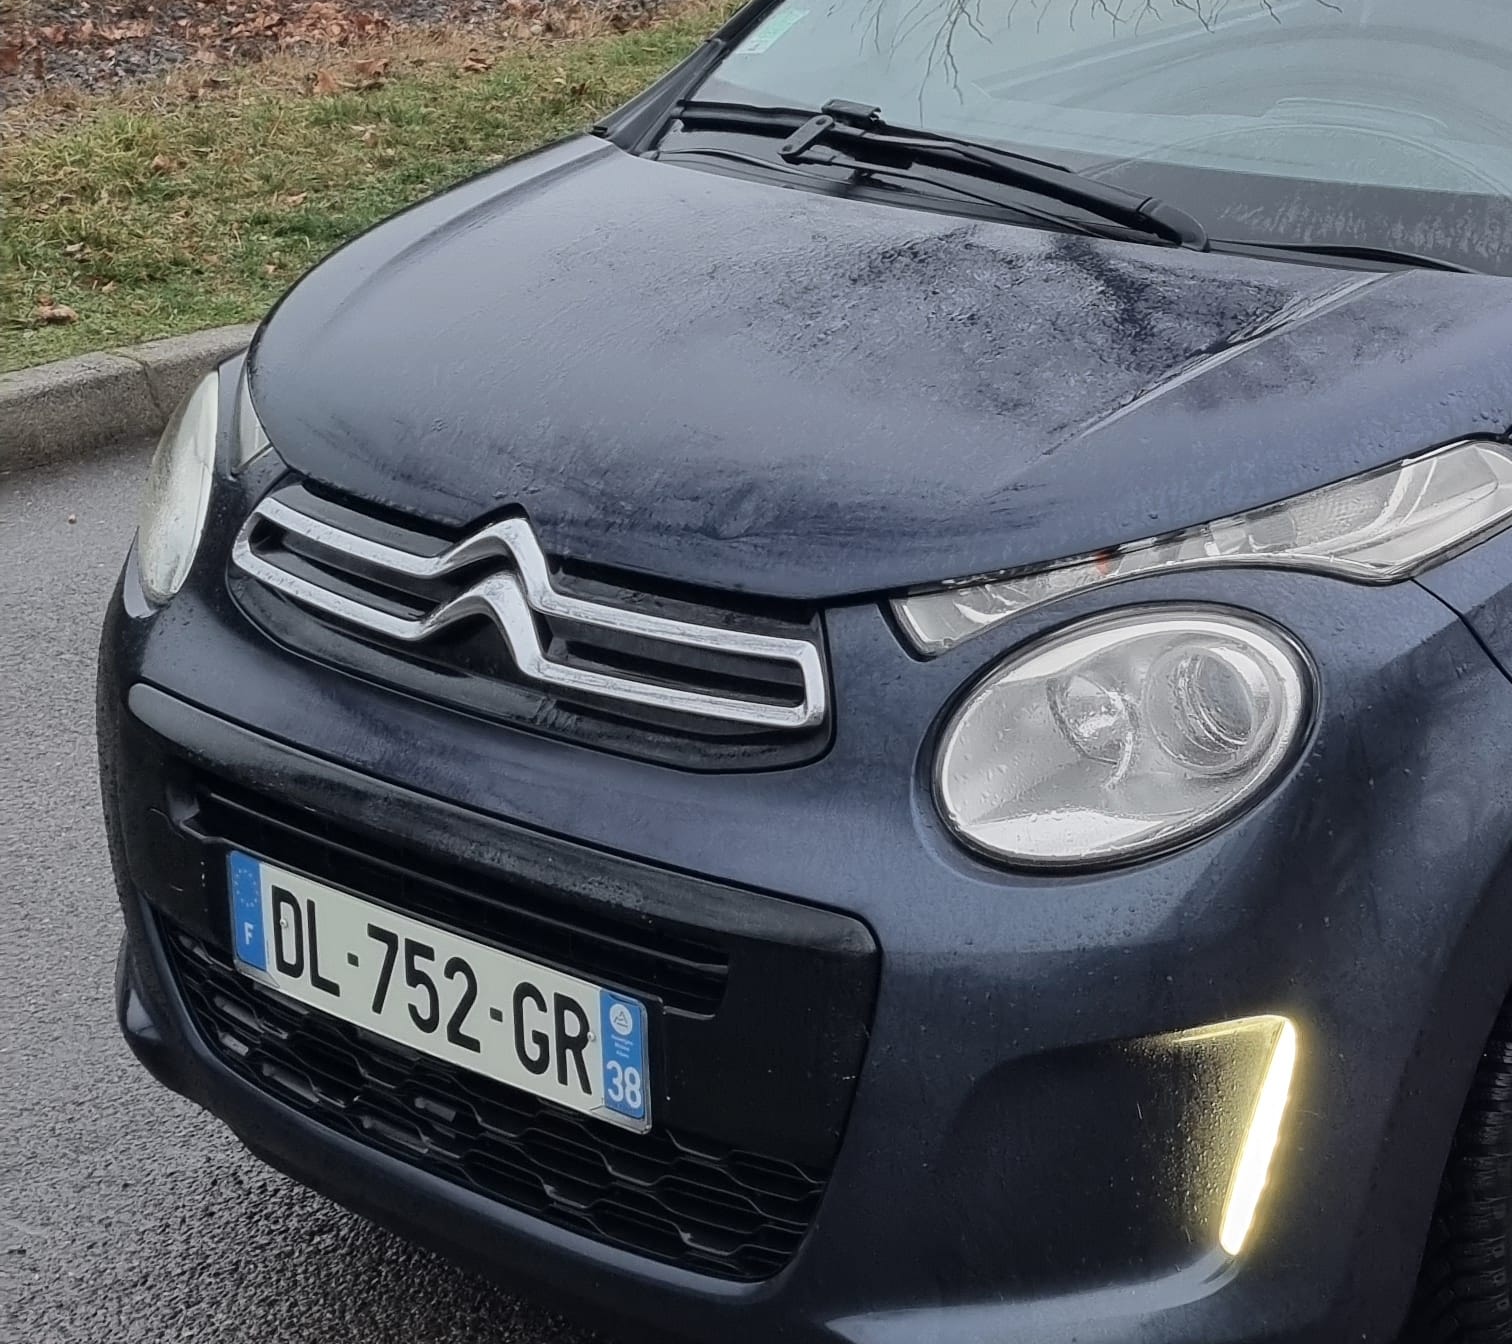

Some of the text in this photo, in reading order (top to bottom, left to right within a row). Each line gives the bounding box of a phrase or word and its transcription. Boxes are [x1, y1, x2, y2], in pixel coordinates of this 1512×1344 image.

[243, 921, 255, 945] F
[271, 884, 593, 1096] DL-752-GR
[606, 1060, 643, 1110] 38
